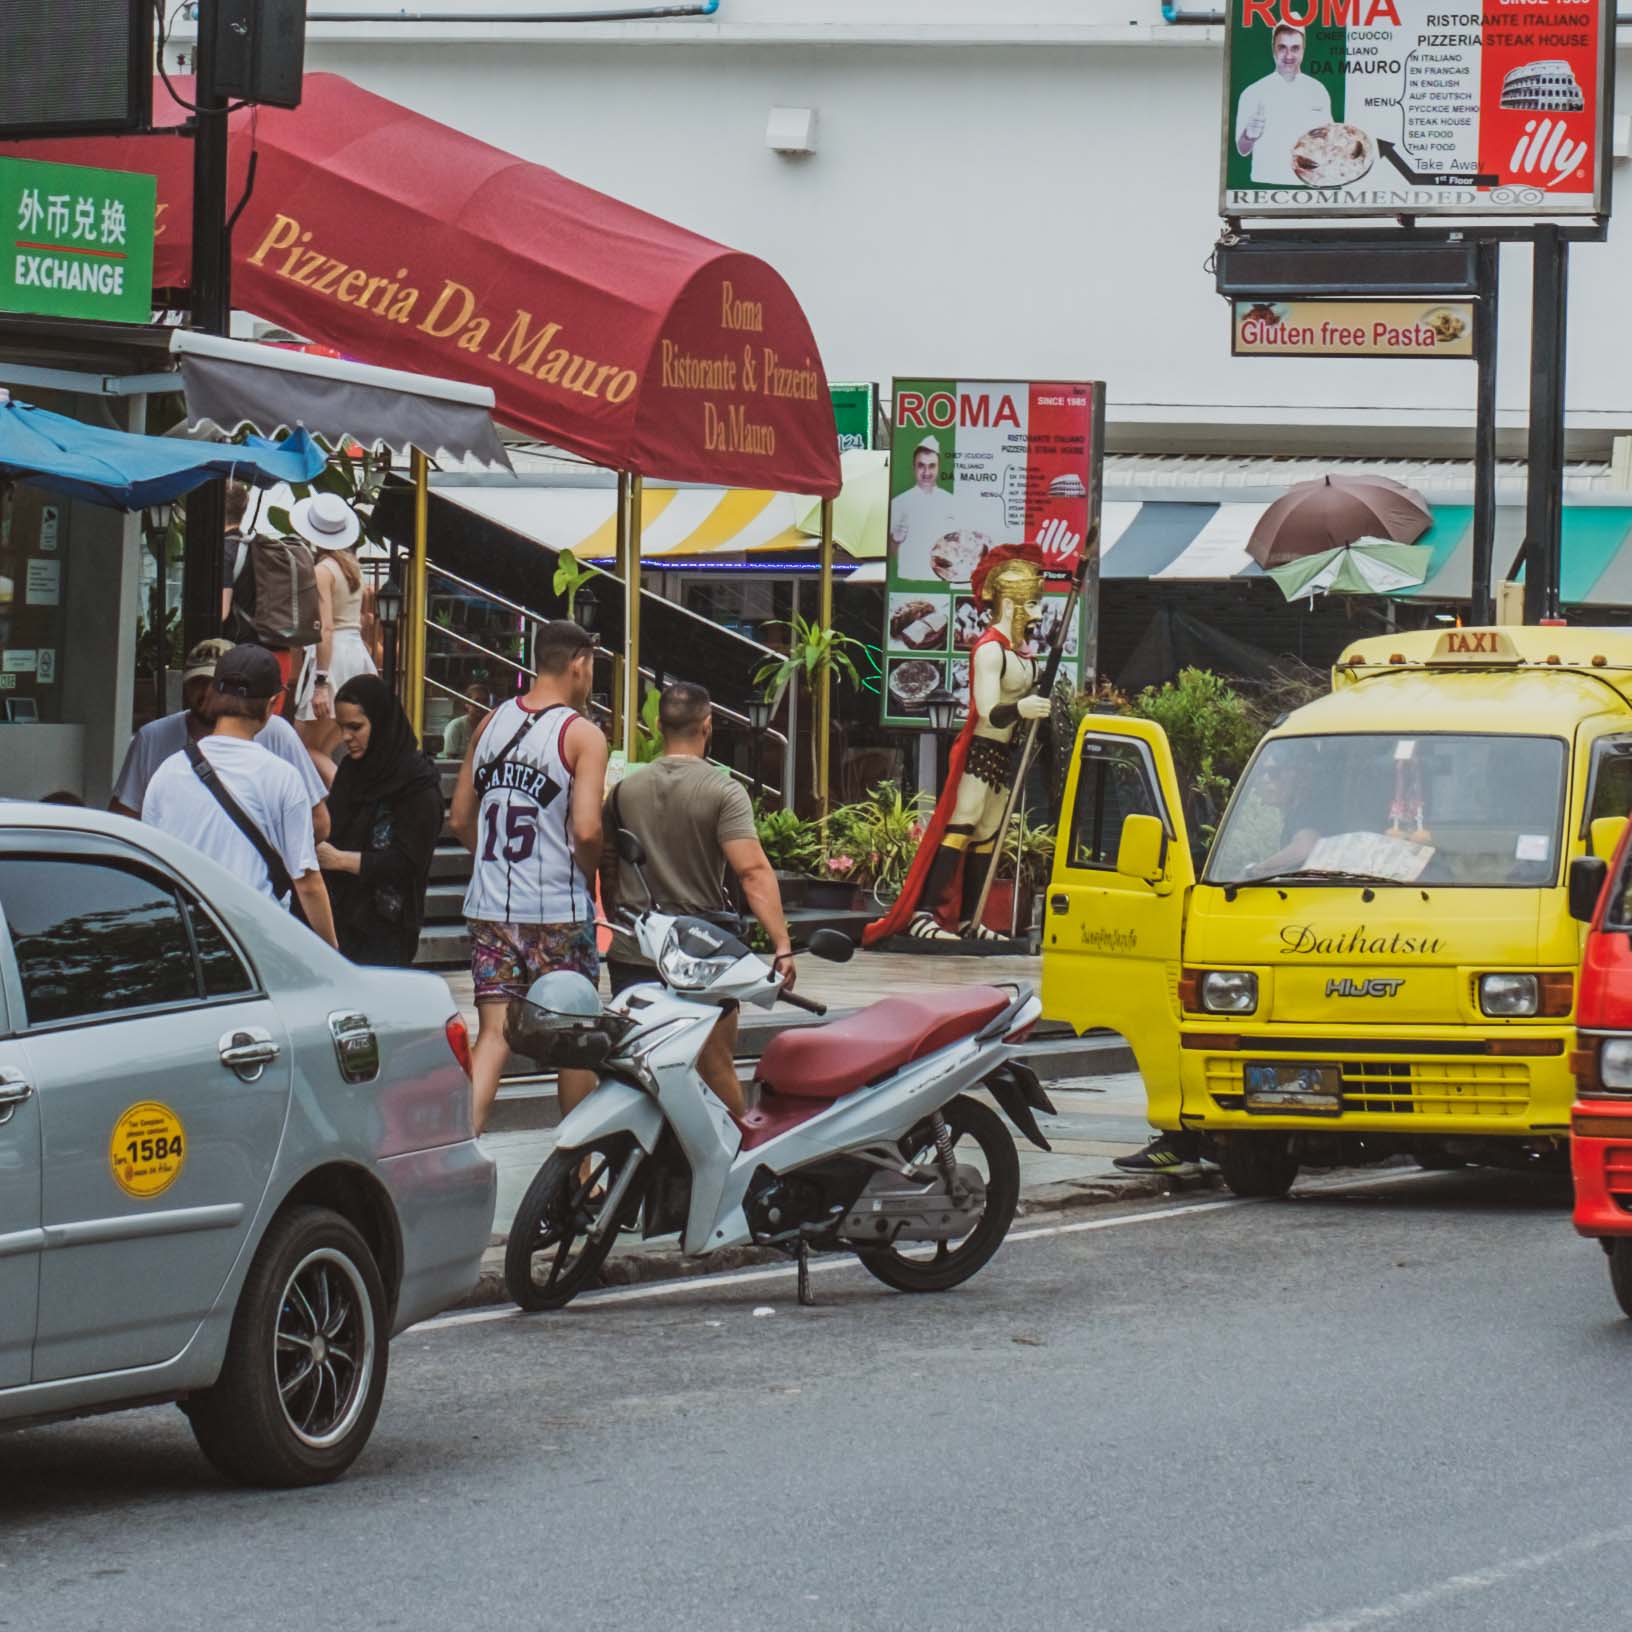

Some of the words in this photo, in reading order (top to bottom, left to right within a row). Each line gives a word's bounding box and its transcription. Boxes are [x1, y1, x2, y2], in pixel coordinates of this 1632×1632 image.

[1426, 14, 1519, 27] RISTORANTE
[1522, 14, 1590, 27] ITALIANO
[1330, 46, 1379, 56] ITALIANO
[1418, 34, 1483, 47] PIZZERIA
[1487, 34, 1535, 47] STEAK
[1538, 34, 1590, 47] HOUSE
[1309, 60, 1332, 74] DA
[1341, 60, 1402, 74] MAURO
[1364, 98, 1398, 107] MENU
[1415, 158, 1444, 170] Take
[1509, 118, 1588, 187] illy
[1231, 189, 1477, 207] RECOMMENDED
[17, 187, 127, 246] 外币兑换
[14, 254, 124, 296] EXCHANGE
[247, 213, 419, 327] Pizzeria
[415, 279, 485, 356] Da
[488, 308, 640, 406] Mauro
[720, 280, 764, 334] Roma
[1240, 320, 1315, 348] Gluten
[1320, 320, 1366, 347] free
[1372, 321, 1437, 348] Pasta
[661, 337, 738, 395] Ristorante
[742, 344, 759, 395] &
[763, 347, 820, 403] Pizzeria
[896, 391, 1022, 429] ROMA
[1037, 396, 1065, 406] SINCE
[704, 401, 729, 452] Da
[728, 403, 776, 459] Mauro
[960, 472, 998, 482] MAURO
[1036, 518, 1081, 561] illy
[1446, 631, 1499, 655] TAXI
[478, 761, 547, 798] CARTER
[481, 802, 539, 864] 15
[1279, 923, 1447, 955] Daihatsu
[1325, 978, 1406, 998] HIJET
[126, 1135, 183, 1163] 1584
